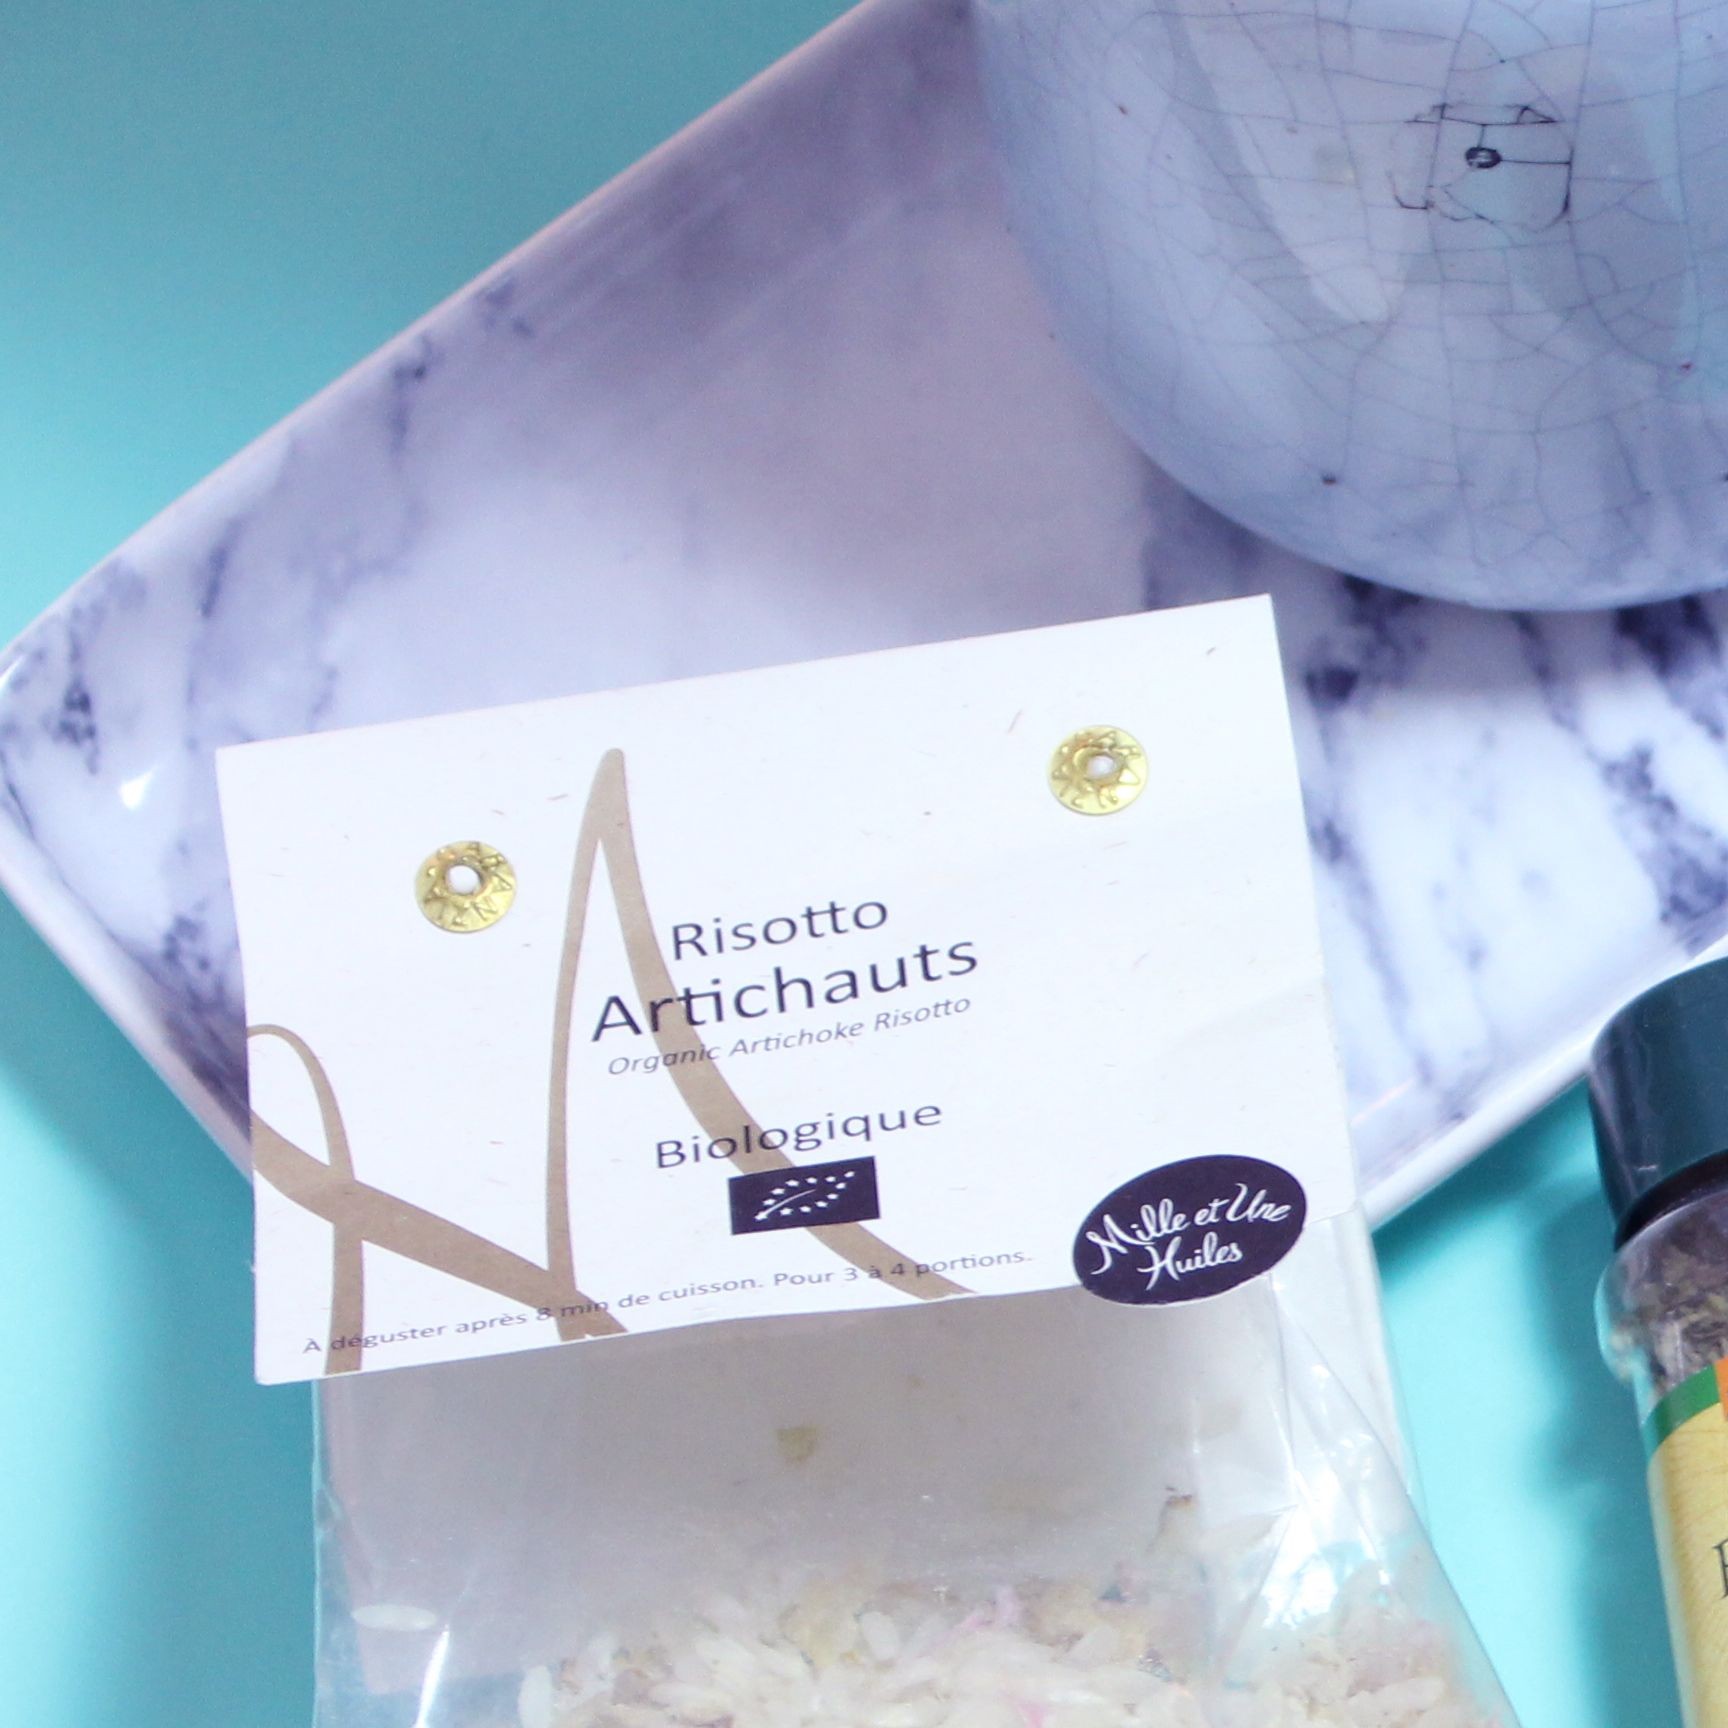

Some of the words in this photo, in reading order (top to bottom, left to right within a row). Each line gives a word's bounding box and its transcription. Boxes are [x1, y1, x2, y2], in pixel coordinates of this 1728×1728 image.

[672, 901, 888, 961] Risotto
[591, 940, 978, 1042] Artichauts
[607, 1043, 721, 1076] Organic
[728, 1020, 864, 1057] Artichoke
[874, 998, 971, 1031] Risotto
[656, 1105, 942, 1169] Biologique
[1086, 1198, 1190, 1275] Mille
[1194, 1198, 1230, 1225] et
[1225, 1183, 1292, 1222] Une
[1137, 1232, 1242, 1291] Huiles
[331, 1324, 444, 1350] déguster
[455, 1313, 527, 1336] après
[536, 1307, 550, 1321] 8
[560, 1300, 608, 1318] min
[618, 1292, 649, 1308] de
[659, 1276, 763, 1301] cuisson.
[774, 1271, 831, 1287] Pour
[845, 1267, 857, 1281] 3
[869, 1265, 882, 1279] à
[891, 1263, 905, 1276] 4
[915, 1249, 1033, 1278] portions.
